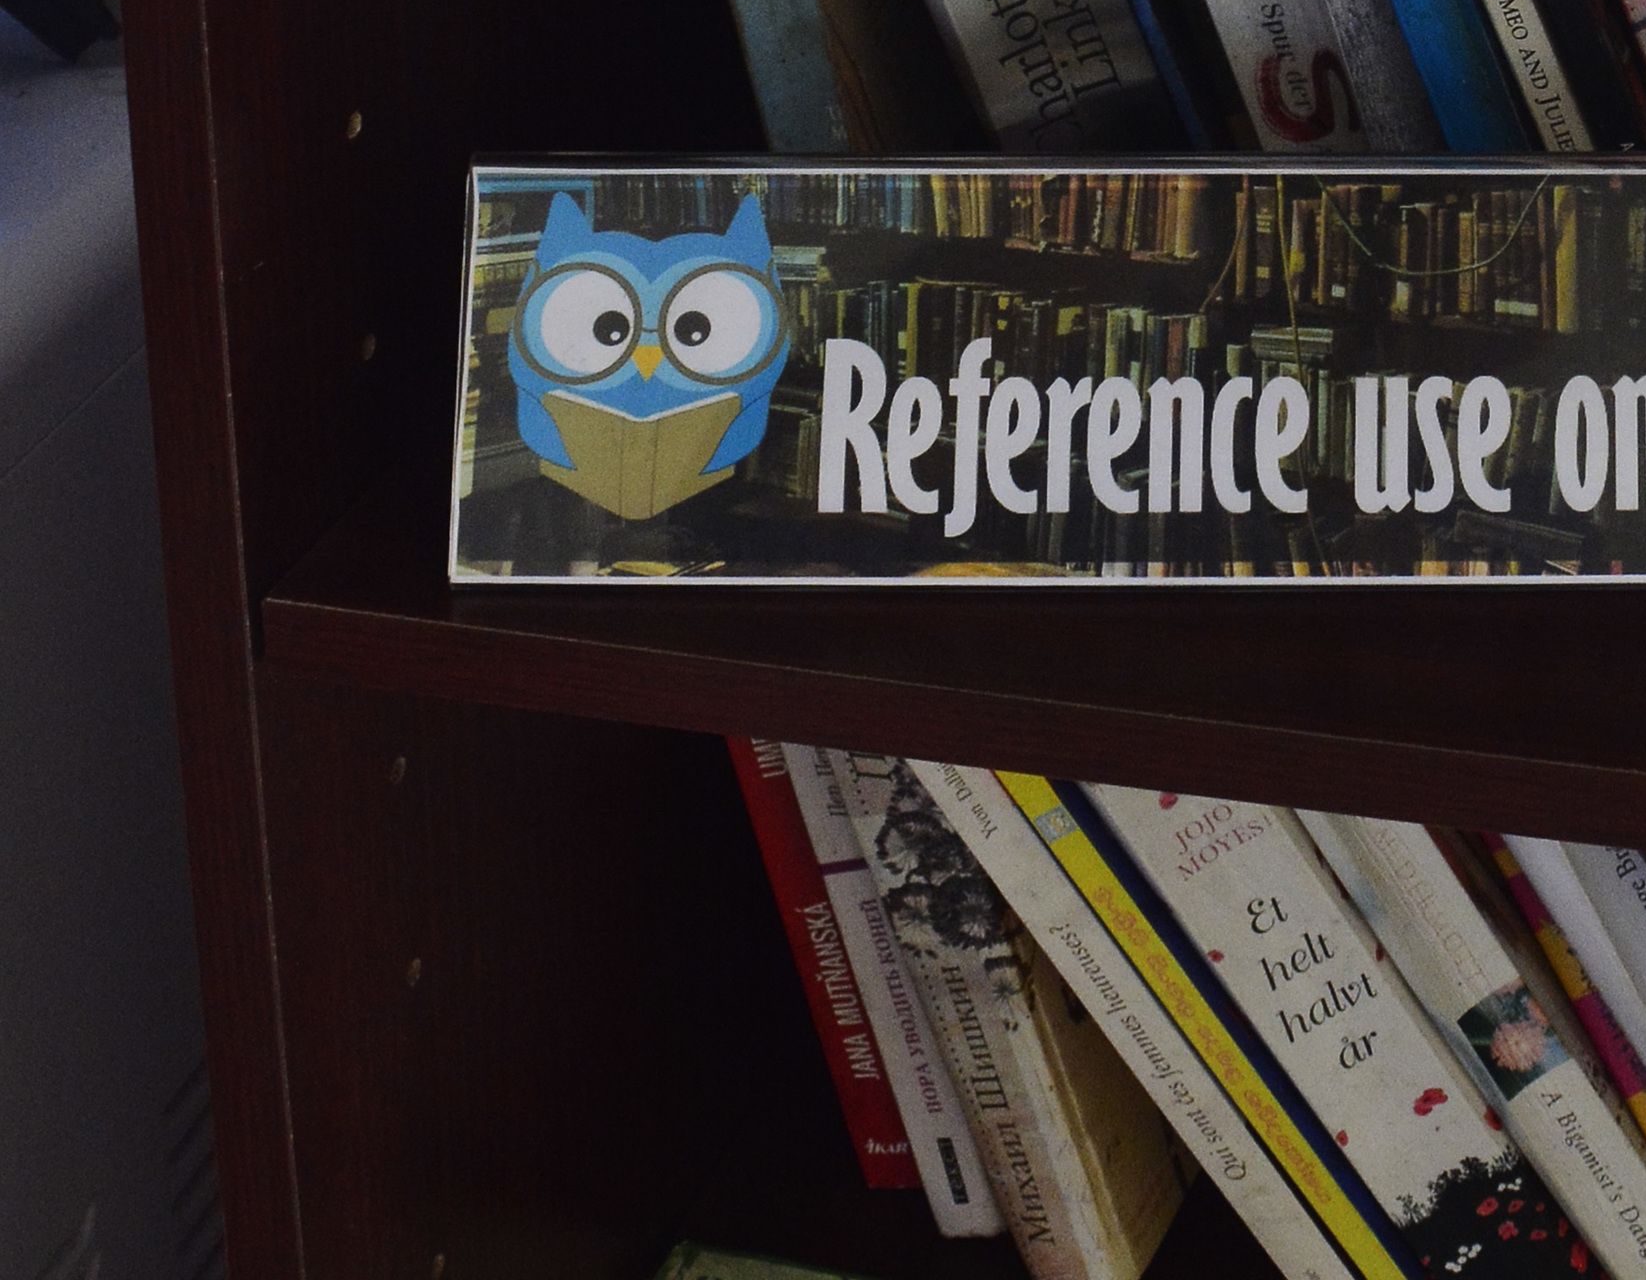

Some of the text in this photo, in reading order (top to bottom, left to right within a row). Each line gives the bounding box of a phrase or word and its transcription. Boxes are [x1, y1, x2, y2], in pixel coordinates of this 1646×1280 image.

[817, 336, 1309, 538] Reference
[1353, 373, 1514, 515] use
[970, 797, 1000, 839] Yvon
[1175, 804, 1234, 855] JOJO
[796, 901, 882, 1081] JANA MUTŇANSKÁ
[1048, 917, 1129, 1018] heureuses?
[1260, 932, 1336, 991] helt
[942, 965, 1009, 1111] Шишкин
[1275, 972, 1379, 1043] halvt
[1116, 1010, 1179, 1085] femmes
[1338, 1029, 1379, 1070] år
[1185, 1104, 1223, 1147] sont
[1540, 1090, 1563, 1111] A
[1557, 1112, 1623, 1204] Bigamist's
[998, 1118, 1056, 1245] Михаил
[1211, 1140, 1252, 1185] Qui
